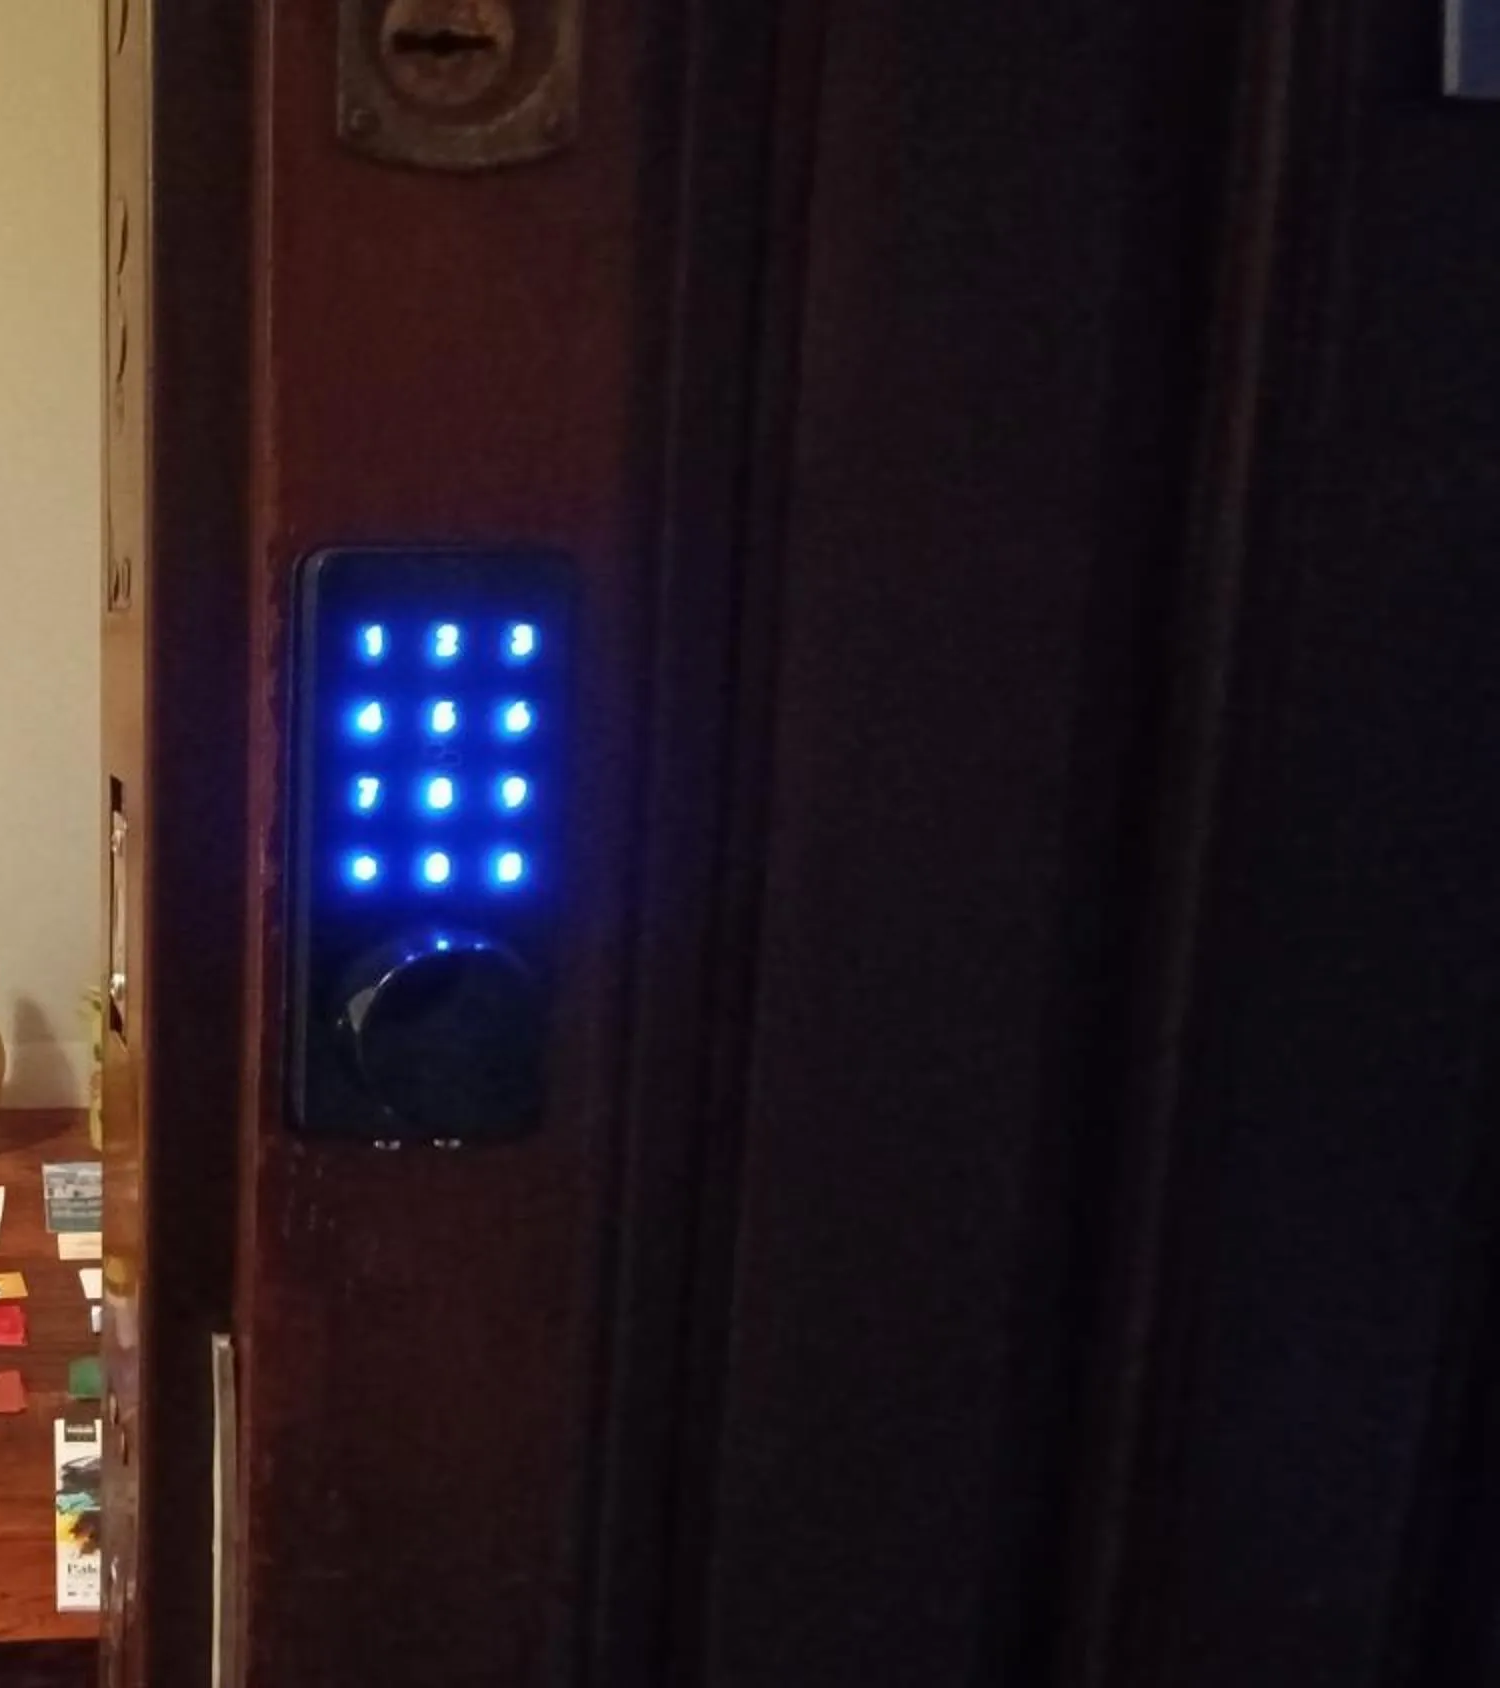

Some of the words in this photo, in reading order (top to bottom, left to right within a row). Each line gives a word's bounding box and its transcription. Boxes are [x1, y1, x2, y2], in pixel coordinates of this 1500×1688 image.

[362, 621, 386, 660] 1
[433, 621, 461, 660] 2
[508, 621, 536, 660] 3
[355, 698, 385, 735] 4
[355, 774, 382, 811] 7
[424, 774, 456, 811] 8
[500, 774, 529, 811] 9
